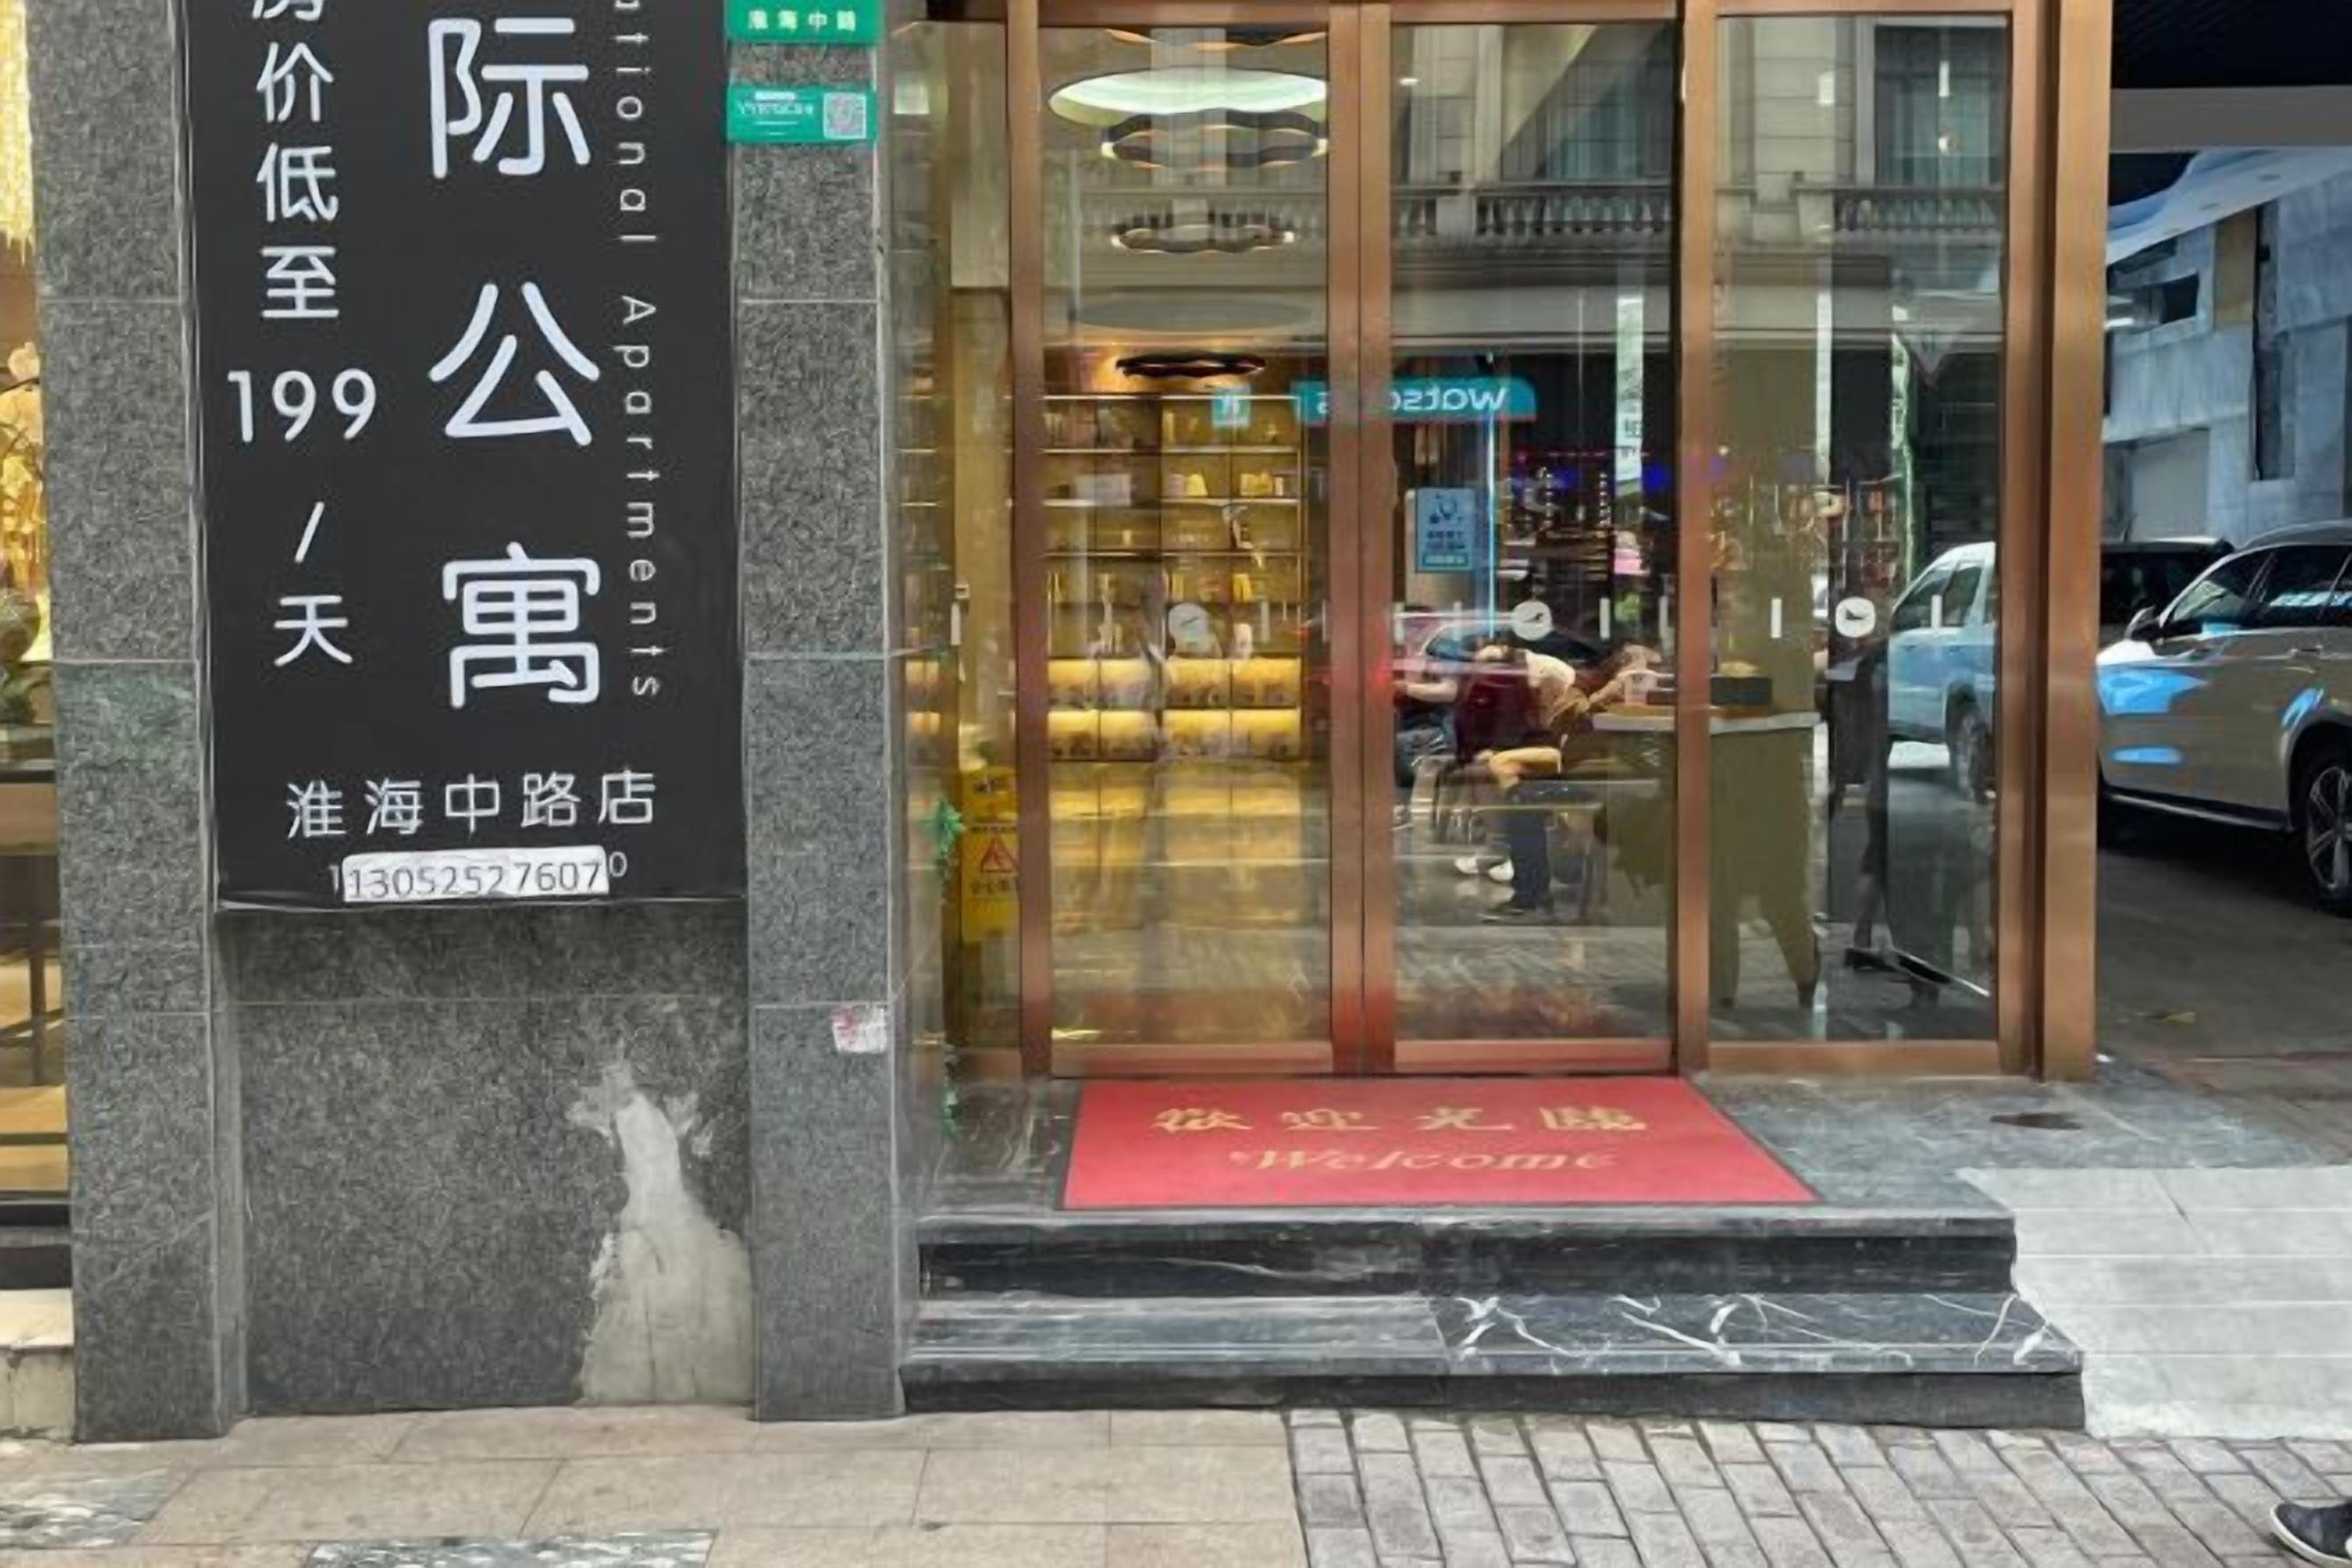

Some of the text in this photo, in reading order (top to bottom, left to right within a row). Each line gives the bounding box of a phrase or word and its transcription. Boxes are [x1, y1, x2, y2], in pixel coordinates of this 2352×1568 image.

[429, 17, 601, 708] 际公寓
[227, 368, 377, 443] 199
[614, 295, 664, 696] Apartments
[286, 769, 656, 839] 淮海中路店
[1229, 1149, 1618, 1170] Welcome
